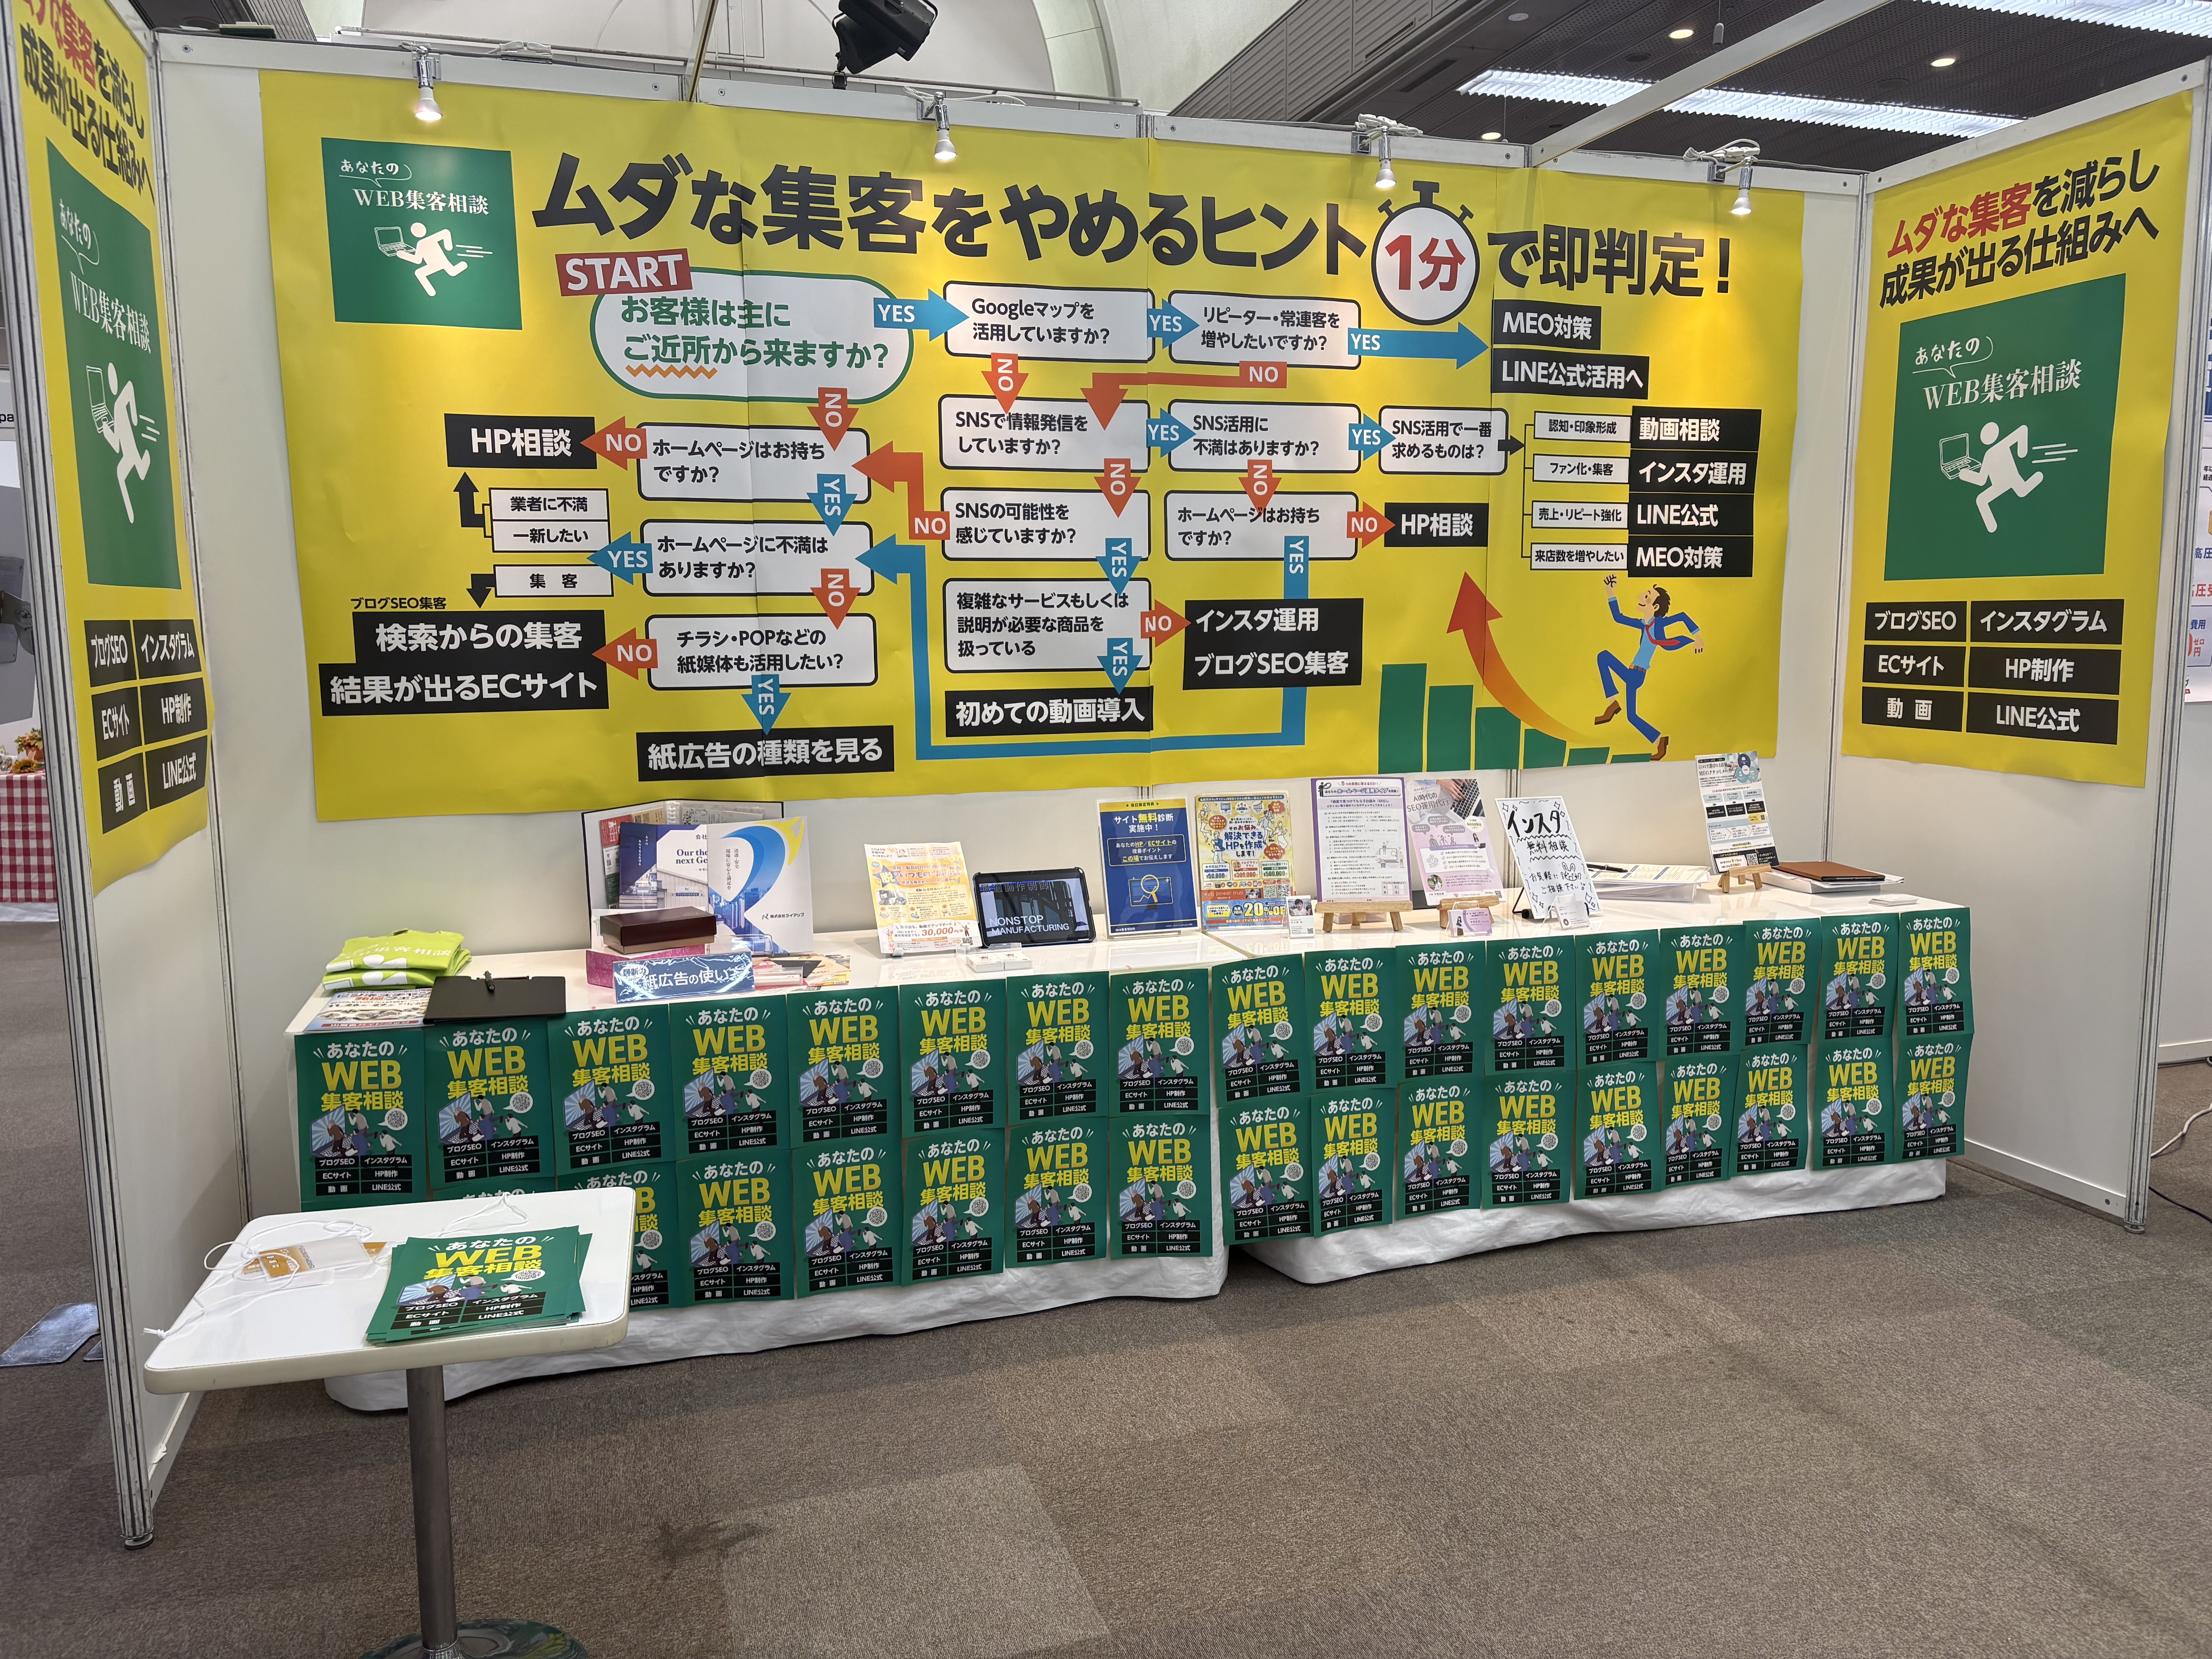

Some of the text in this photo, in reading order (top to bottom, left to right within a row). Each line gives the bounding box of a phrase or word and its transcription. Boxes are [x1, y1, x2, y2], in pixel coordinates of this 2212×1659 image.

[20, 22, 155, 206] 成果が出る仕組みへ
[340, 159, 399, 175] あなたの
[353, 188, 489, 215] WEB集客相談
[1887, 148, 2160, 258] ムダな集客を減らし
[59, 199, 91, 250] あなたの
[532, 153, 1367, 275] ムダな集客をやめるヒント
[1384, 235, 1466, 291] 1分
[1879, 207, 2159, 309] 成果が出る仕組みへ
[567, 253, 684, 291] START
[70, 270, 151, 354] WEB集客相談
[621, 296, 790, 328] お客様は主に
[878, 305, 915, 323] YES
[972, 298, 1094, 321] Googleマップを
[1203, 307, 1340, 329] リピーター・常連客を
[973, 323, 1109, 345] 活用していますか？
[1149, 316, 1182, 332] YES
[1502, 312, 1592, 340] MEO対策
[624, 333, 889, 369] ご近所から来ますか？
[1201, 331, 1327, 351] 増やしたいですか？
[1351, 333, 1381, 350] YES
[1915, 337, 1980, 365] あなたの
[998, 358, 1014, 391] NO
[1249, 367, 1279, 383] NO
[1502, 361, 1644, 390] LINE公式活用へ
[1923, 359, 2082, 410] WEB集客相談
[824, 393, 842, 427] NO
[955, 412, 1088, 432] SNSで情報発信を
[1193, 416, 1269, 432] SNS活用に
[1392, 420, 1492, 437] SNS活用で一番
[1549, 419, 1617, 435] 認知・印象形成
[1639, 417, 1721, 442] 動画相談
[471, 428, 572, 457] HP相談
[606, 434, 642, 452] NO
[1148, 425, 1180, 441] YES
[1352, 429, 1381, 445] YES
[653, 438, 825, 460] ホームページはお持ち
[959, 437, 1060, 455] していますか？
[1193, 439, 1320, 456] 不満はありますか？
[1392, 443, 1485, 459] 求めるものは？
[654, 466, 719, 483] ですか？
[1111, 464, 1126, 495] NO
[1549, 462, 1613, 477] ファン化・集客
[1638, 462, 1747, 485] インスタ運用
[1253, 465, 1267, 495] NO
[511, 496, 588, 512] 業者に不満
[824, 479, 841, 516] YES
[955, 503, 1070, 520] SNSの可能性を
[1178, 507, 1320, 524] ホームページはお持ち
[1539, 507, 1622, 522] 売上・リピート強化
[1637, 504, 1719, 527] LINE公式
[914, 518, 946, 534] NO
[1351, 517, 1378, 532] NO
[1400, 514, 1473, 538] HP相談
[513, 528, 589, 543] 一新したい
[658, 535, 828, 554] ホームページに不満は
[955, 527, 1077, 544] 感じていますか？
[1178, 530, 1232, 547] ですか？
[608, 551, 648, 568] YES
[1111, 542, 1127, 577] YES
[1289, 539, 1304, 574] YES
[1535, 547, 1624, 562] 来店数を増やしたい
[1636, 546, 1723, 568] MEO対策
[659, 562, 756, 579] ありますか？
[828, 574, 844, 606] NO
[350, 597, 447, 610] ブログSEO集客
[957, 592, 1129, 610] 複雑なサービスもしくは
[957, 616, 1104, 633] 説明が必要な商品を
[1145, 616, 1172, 631] NO
[1195, 608, 1319, 632] インスタ運用
[1875, 610, 1956, 630] ブログSEO
[1980, 609, 2107, 633] インスタグラム
[141, 630, 195, 663] インスタグラム
[376, 622, 582, 652] 検索からの集客
[677, 629, 826, 647] チラシ・POPなどの
[91, 635, 128, 668] ブログSEO
[617, 645, 652, 662] NO
[958, 640, 1036, 658] 扱っている
[677, 654, 843, 673] 紙媒体も活用したい？
[1112, 642, 1128, 677] YES
[1194, 651, 1349, 677] ブログSEO集客
[1878, 655, 1944, 676] ECサイト
[2005, 658, 2075, 683] HP制作
[330, 673, 597, 705] 結果が出るECサイト
[758, 678, 774, 715] YES
[162, 693, 192, 726] HP制作
[956, 698, 1145, 726] 初めての動画導入
[1996, 705, 2081, 732] LINE公式
[102, 704, 130, 740] ECサイト
[648, 738, 883, 771] 紙広告の種類を見る
[163, 753, 197, 789] LINE公式
[1407, 799, 1449, 812] SEO運用代行
[1413, 793, 1437, 802] AI時代の
[1114, 812, 1173, 824] サイト無料診断
[1508, 810, 1560, 837] インスタ
[1129, 824, 1158, 833] 実施中！
[1224, 832, 1263, 840] 解決できる
[1225, 840, 1263, 850] HPを作成
[1527, 840, 1569, 855] 無料相談
[1529, 871, 1558, 881] お気軽に
[989, 915, 1044, 926] NONSTOP
[992, 923, 1069, 935] MANUFACTURING
[1913, 917, 1952, 931] あなたの
[922, 927, 953, 936] 30,000
[1910, 931, 1956, 955] WEB
[1910, 954, 1957, 971] 集客相談
[327, 1041, 395, 1059] あなたの
[321, 1060, 402, 1091] WEB
[321, 1091, 404, 1112] 集客相談
[319, 1158, 355, 1166] ブログSEO
[364, 1156, 407, 1165] インスタグラム
[323, 1170, 352, 1180] ECサイト
[446, 1236, 536, 1251] あなたの
[435, 1245, 542, 1268] WEB
[423, 1260, 542, 1280] 集客相談
